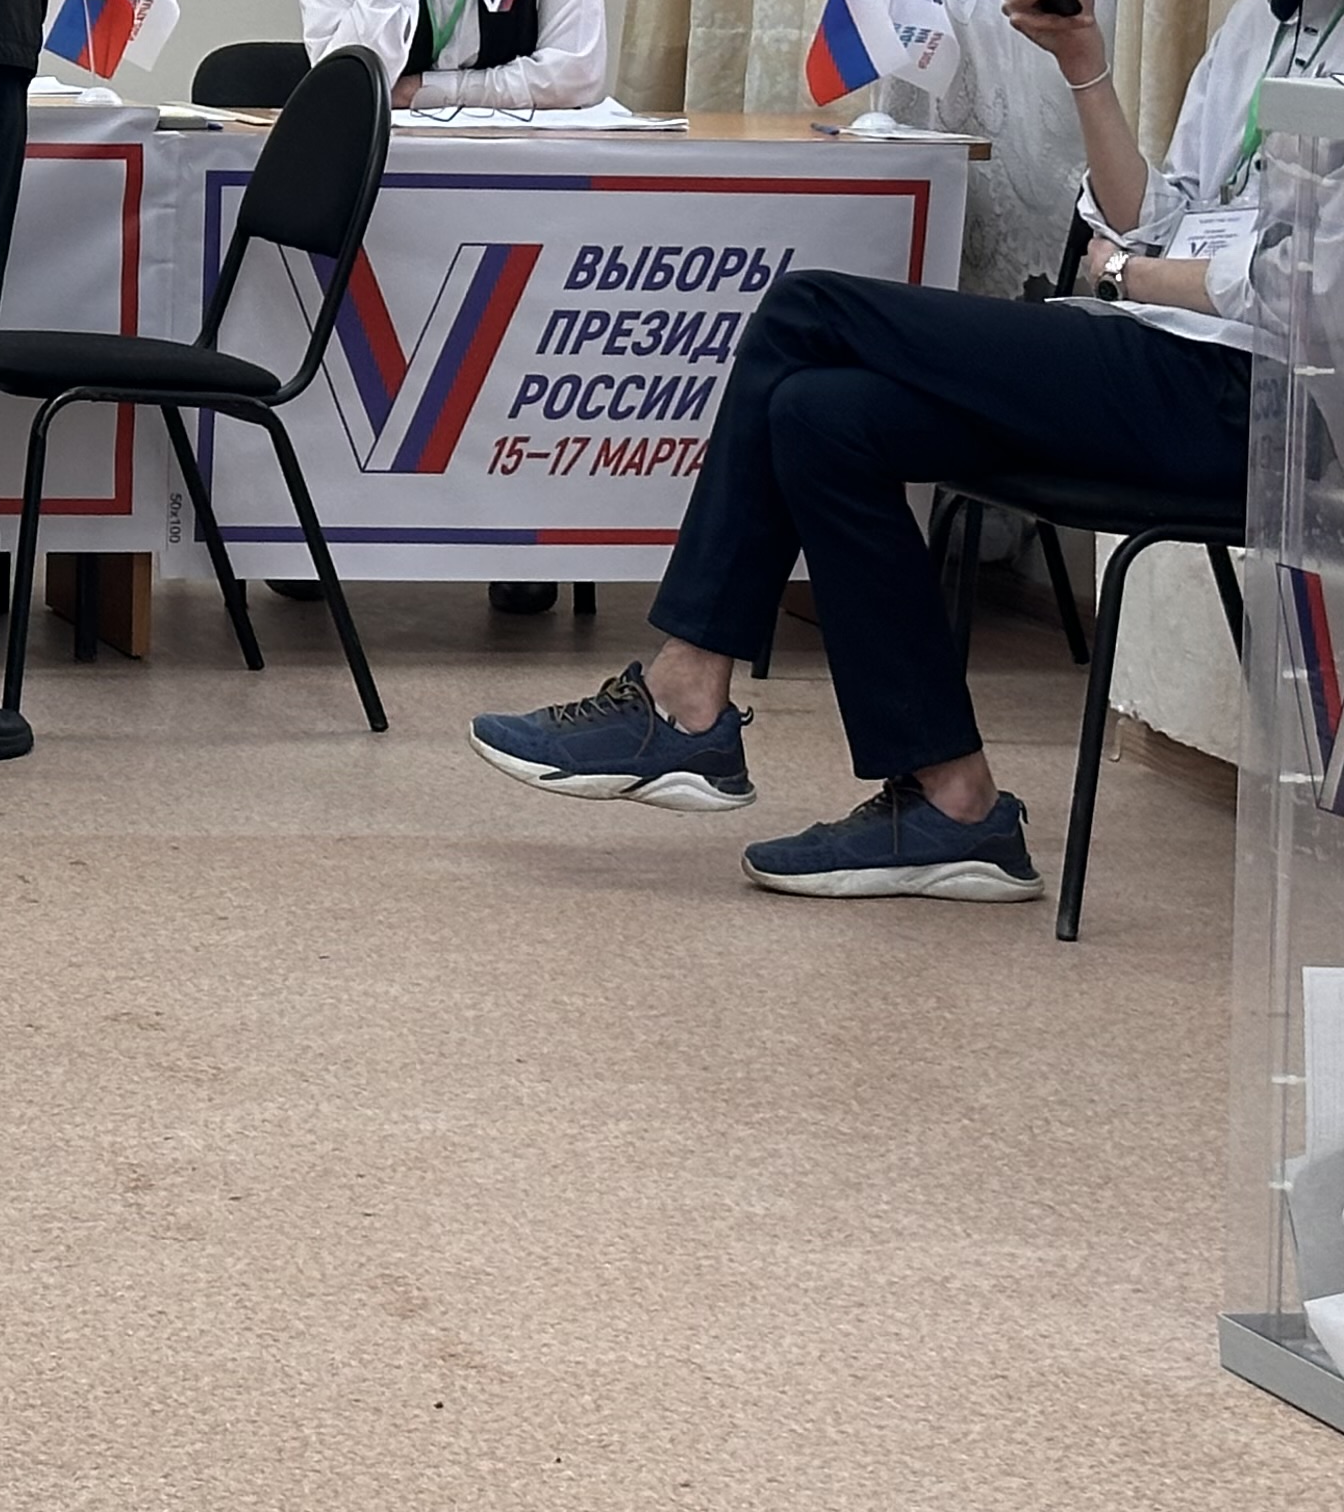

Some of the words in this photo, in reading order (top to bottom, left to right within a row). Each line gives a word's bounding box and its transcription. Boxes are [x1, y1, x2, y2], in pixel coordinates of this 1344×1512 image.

[563, 245, 795, 293] ВЫБОРЫ
[535, 309, 743, 364] ПРЕЗИД
[507, 374, 718, 421] РОССИИ
